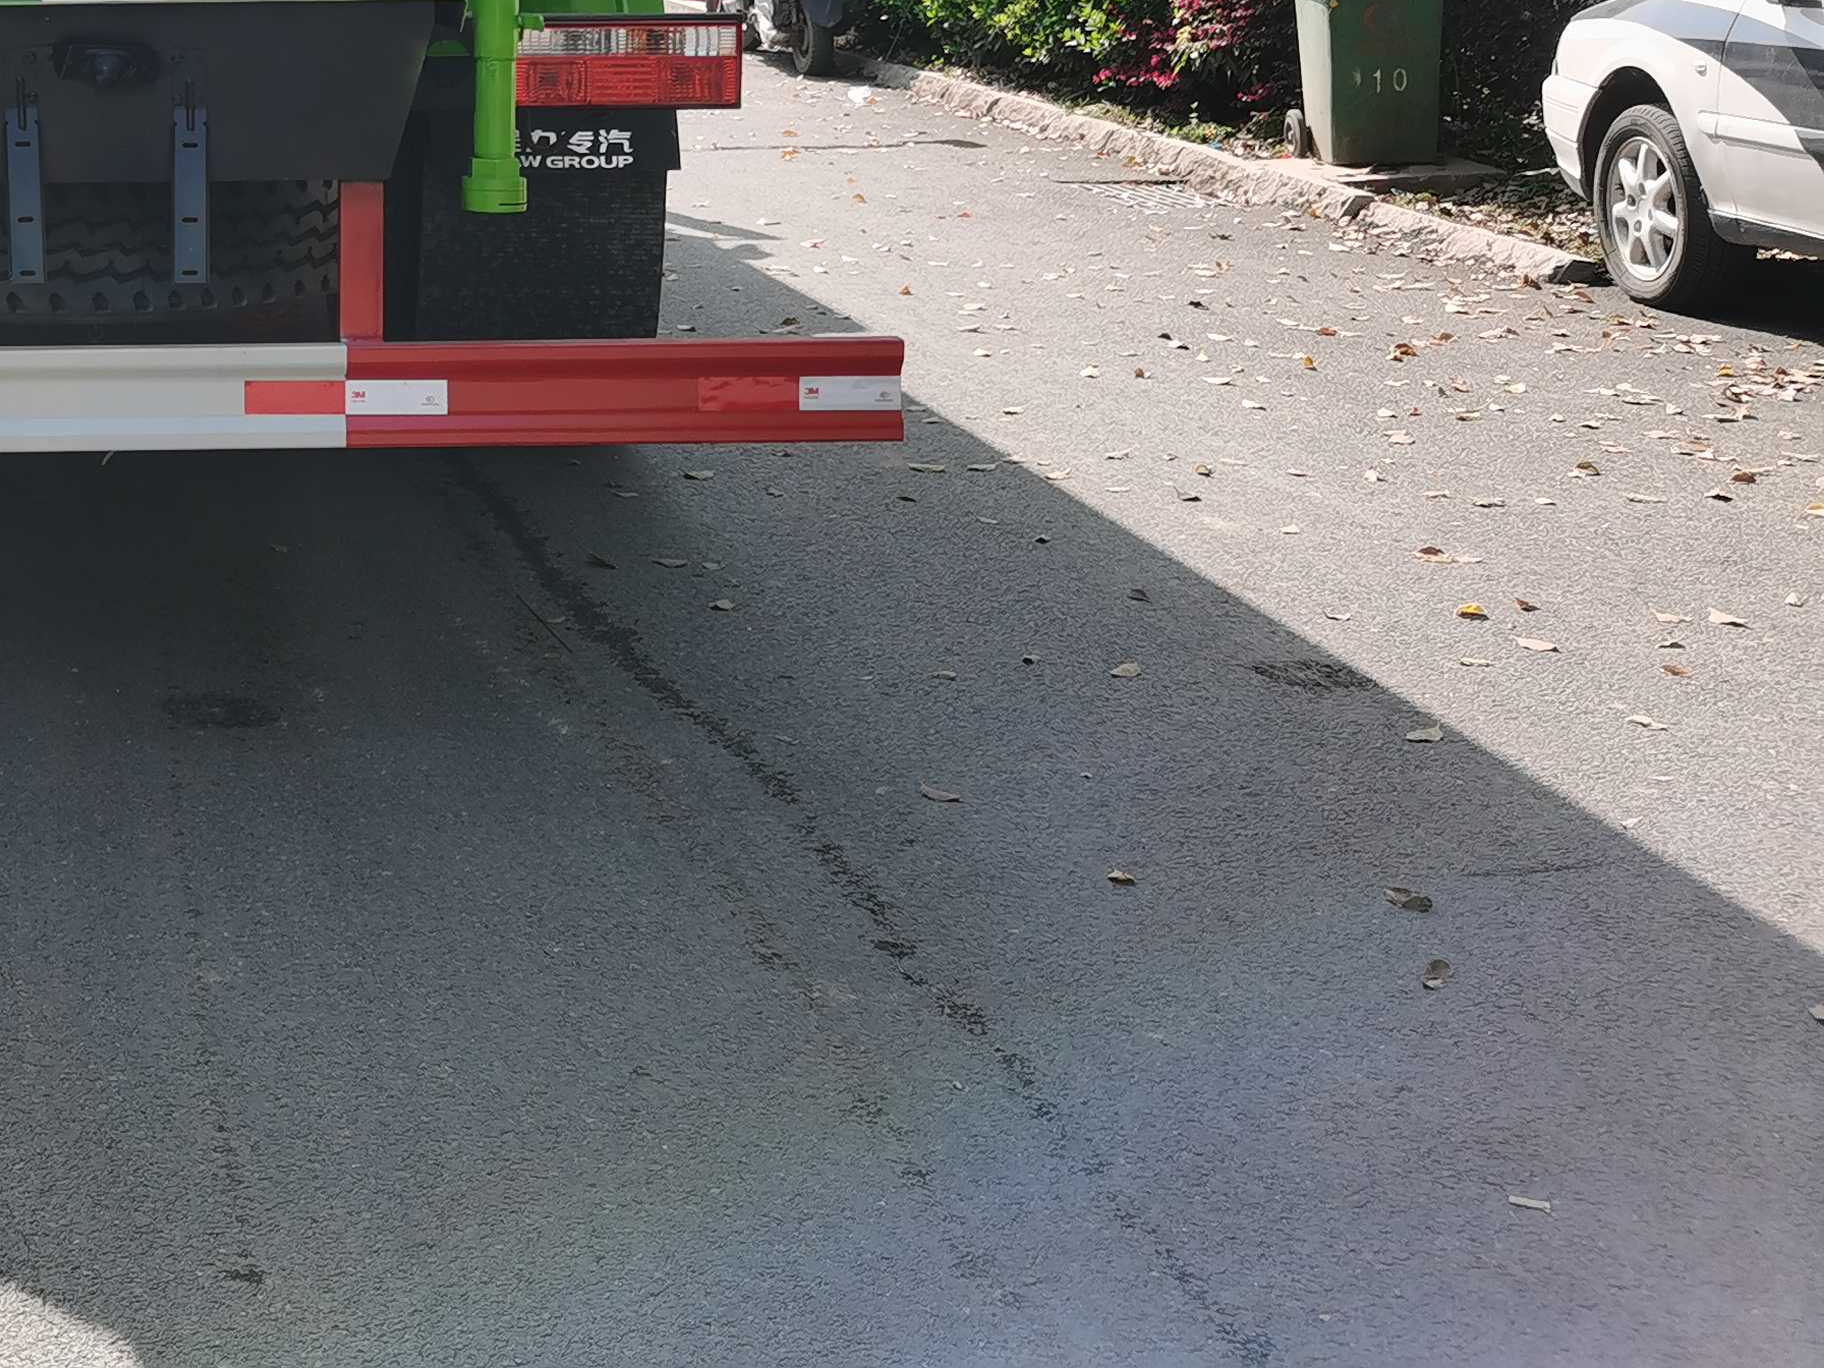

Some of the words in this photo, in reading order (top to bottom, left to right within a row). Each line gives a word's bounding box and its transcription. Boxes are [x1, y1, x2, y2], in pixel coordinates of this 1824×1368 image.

[514, 129, 634, 153] 力专汽
[546, 156, 634, 169] GROUP
[350, 390, 366, 399] 3M
[803, 387, 819, 396] 3M
